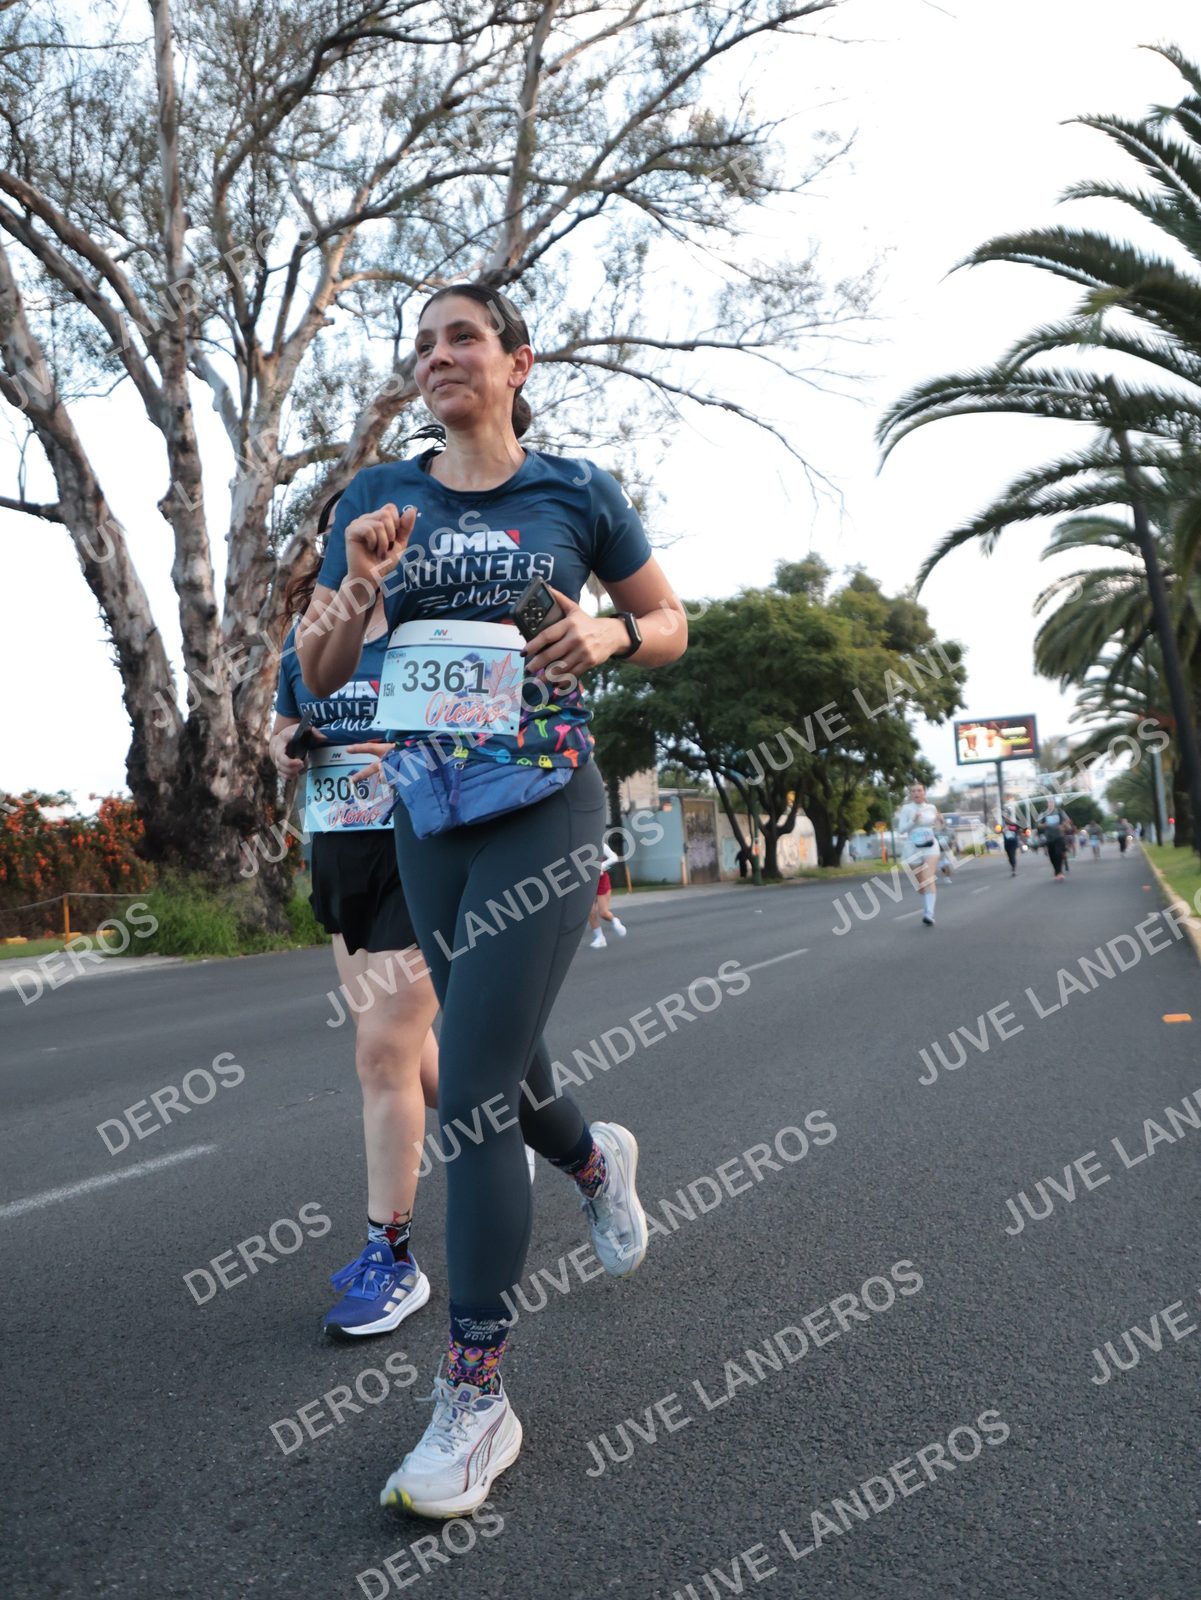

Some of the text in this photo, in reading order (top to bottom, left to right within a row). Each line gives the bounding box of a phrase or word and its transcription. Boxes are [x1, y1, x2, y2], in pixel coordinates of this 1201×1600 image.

[403, 552, 554, 592] RUNNERS
[451, 584, 511, 608] club
[329, 680, 379, 699] MA
[402, 660, 489, 694] 3361
[300, 700, 378, 721] RUNNE
[314, 776, 369, 803] 3306
